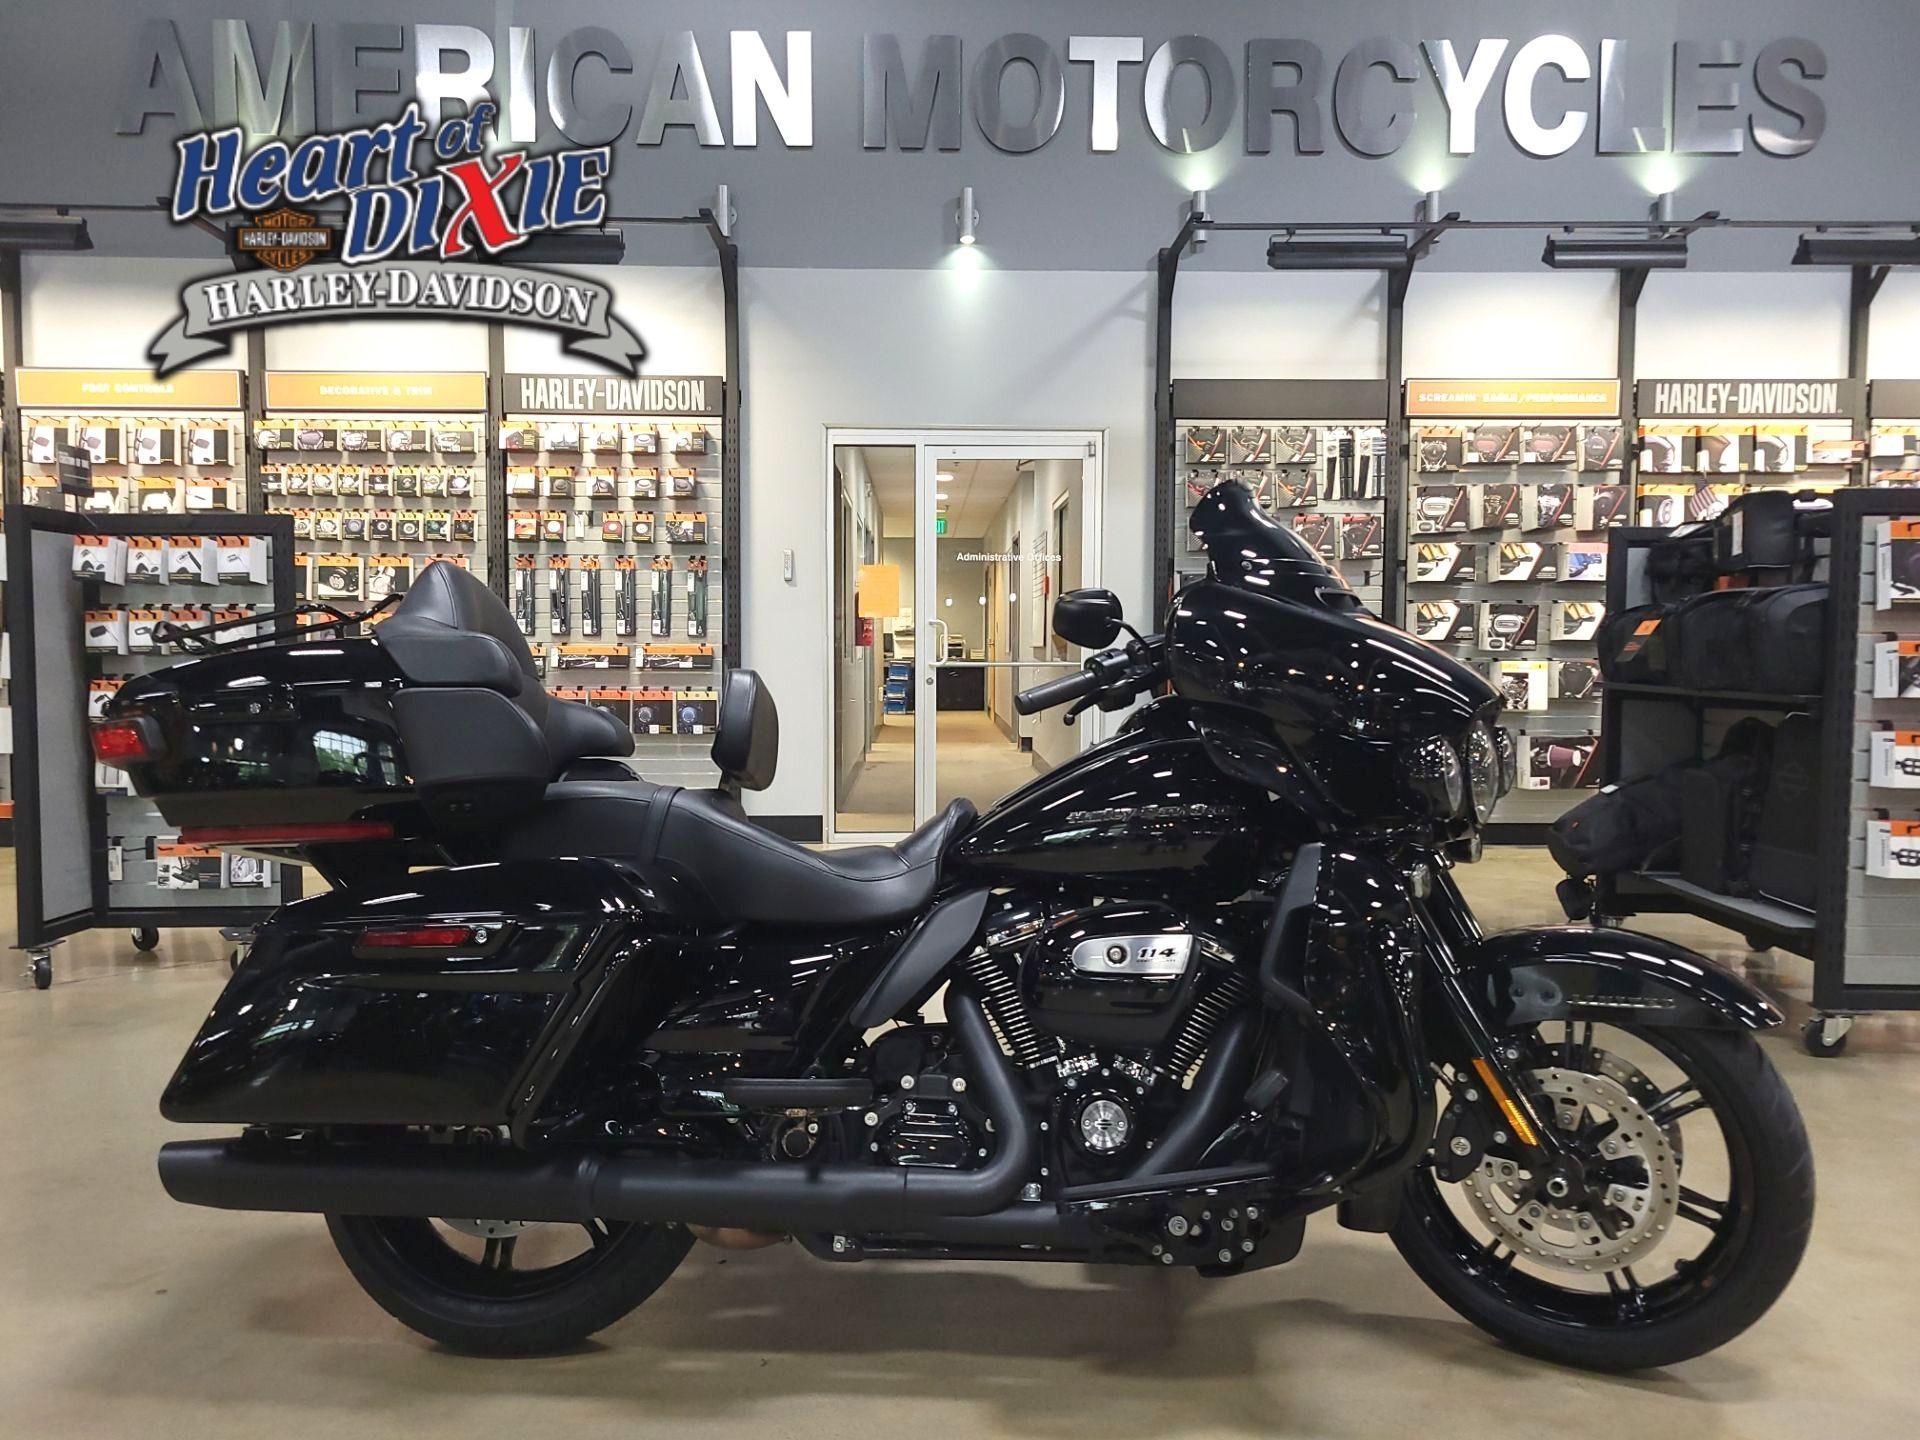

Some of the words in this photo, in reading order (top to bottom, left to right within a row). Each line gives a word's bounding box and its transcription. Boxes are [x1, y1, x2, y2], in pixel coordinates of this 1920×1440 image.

[115, 18, 813, 147] AMERICAN
[863, 33, 1827, 157] MOTORCYCLES
[520, 377, 705, 411] HARLEY-DAVIDSON
[1654, 382, 1838, 414] HARLEY-DAVIDSON
[956, 552, 1024, 562] Administrative
[1139, 947, 1176, 958] 114
